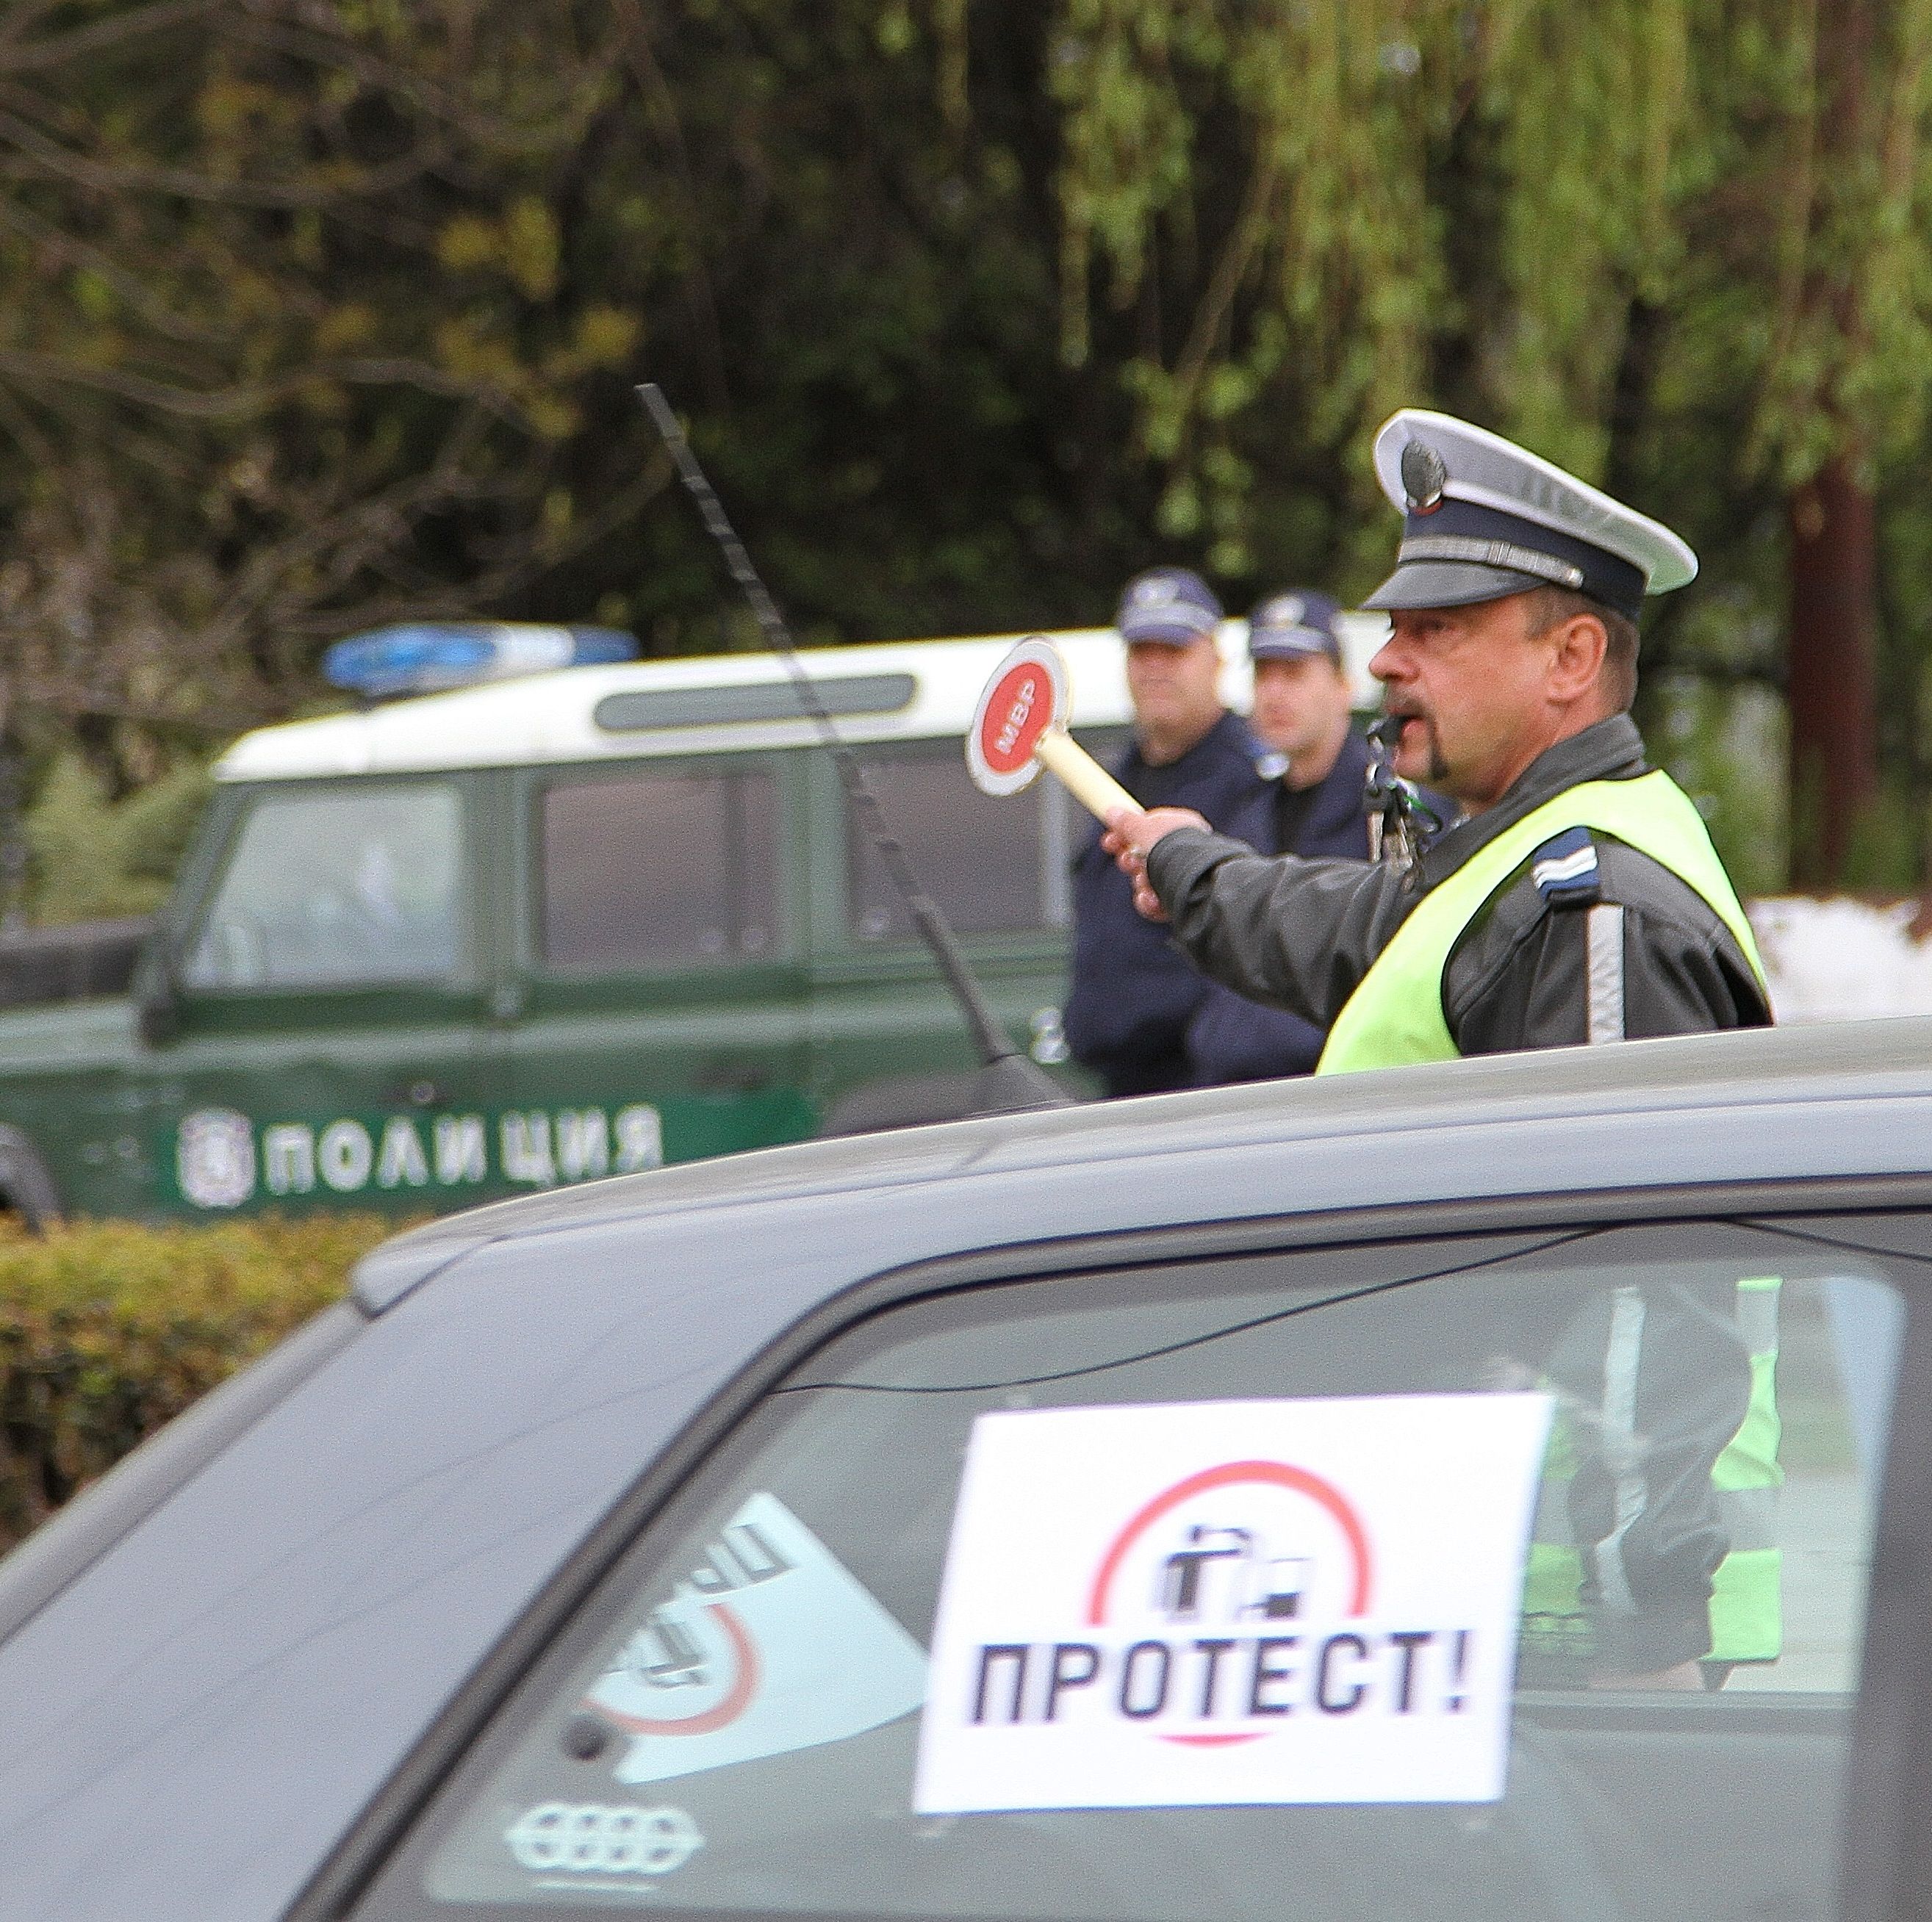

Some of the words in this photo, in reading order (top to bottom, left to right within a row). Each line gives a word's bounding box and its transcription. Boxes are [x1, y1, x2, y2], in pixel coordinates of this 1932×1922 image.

[995, 680, 1035, 754] МВР
[262, 1104, 661, 1194] ПОЛИЦИЯ
[972, 1630, 1471, 1724] ПРОТЕСТ!
